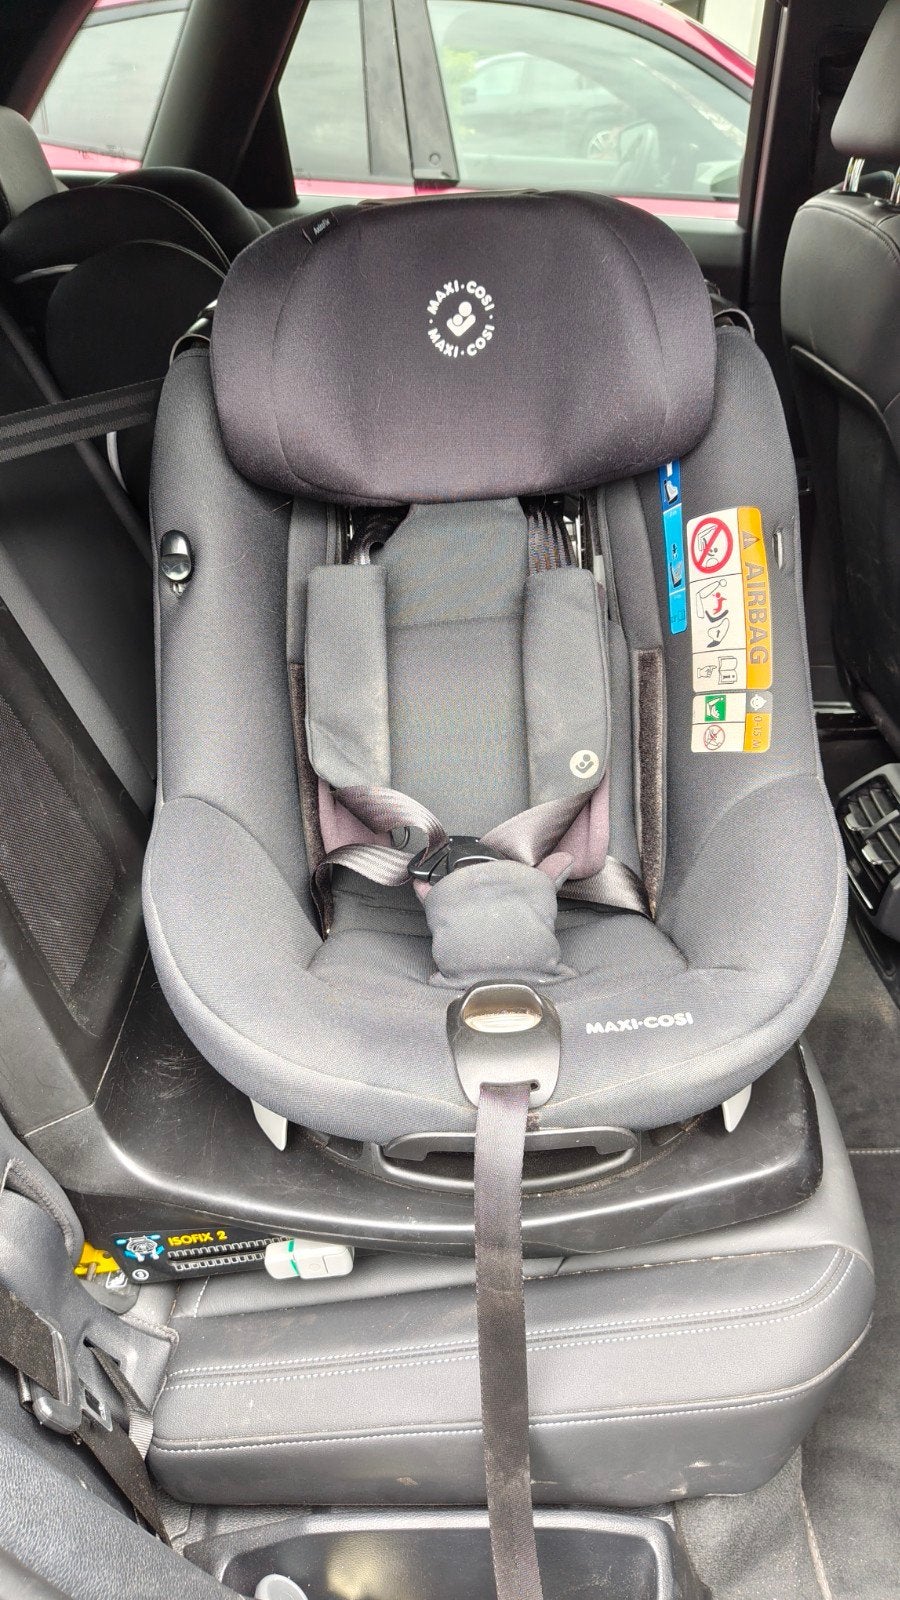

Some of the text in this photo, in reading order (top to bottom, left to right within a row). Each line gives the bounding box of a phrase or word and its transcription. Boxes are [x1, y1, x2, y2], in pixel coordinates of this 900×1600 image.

[745, 561, 769, 665] AIRBAG
[167, 1230, 228, 1246] ISOFIX 2
